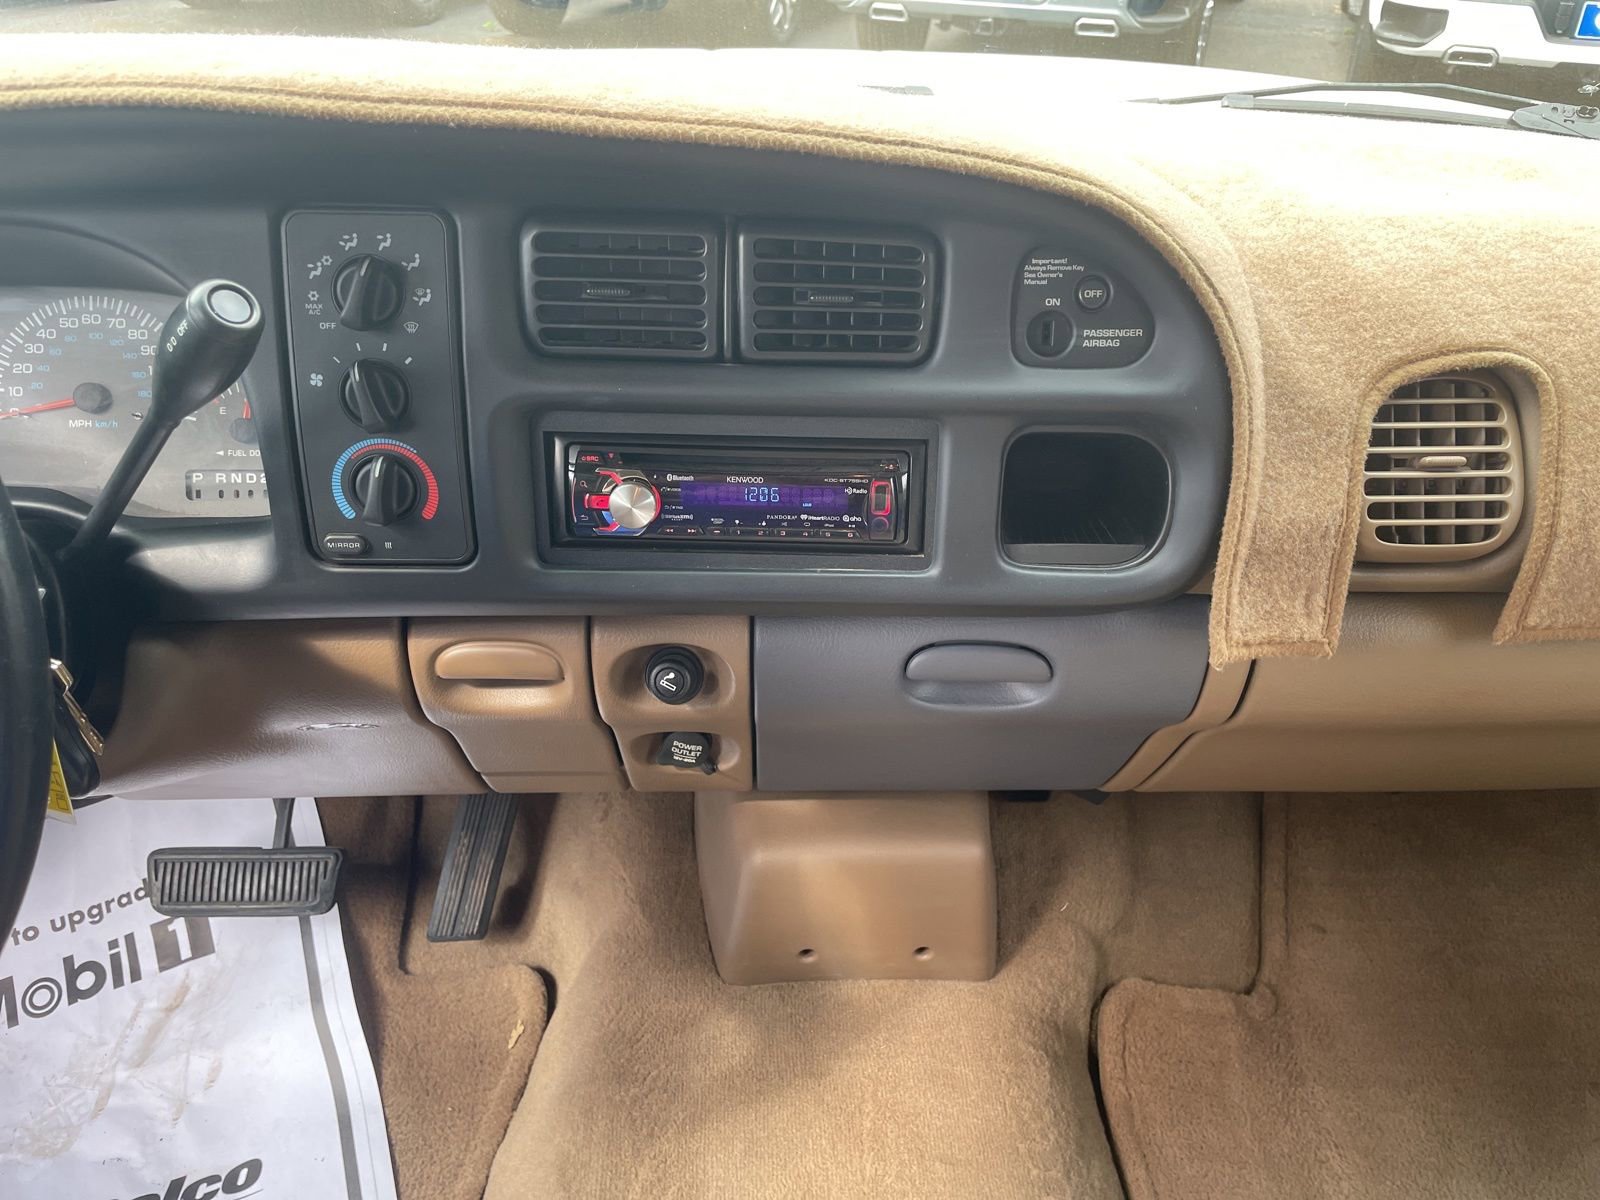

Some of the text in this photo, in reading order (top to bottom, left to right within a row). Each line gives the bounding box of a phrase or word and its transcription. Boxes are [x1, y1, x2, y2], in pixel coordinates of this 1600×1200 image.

[1031, 257, 1067, 265] Important!
[1084, 290, 1103, 298] OFF
[1045, 298, 1061, 306] ON
[59, 318, 79, 328] 50
[82, 314, 101, 325] 60
[106, 318, 126, 329] 70
[177, 319, 189, 336] OFF
[319, 322, 337, 330] OFF
[36, 329, 56, 339] 40
[128, 329, 148, 340] 80
[1083, 329, 1143, 337] PASSENGER
[1083, 339, 1120, 347] AIRBAG
[24, 344, 44, 354] 30
[13, 363, 33, 374] 20
[8, 386, 23, 397] 10
[219, 406, 227, 415] E
[68, 419, 118, 428] MPH km/h
[192, 473, 203, 483] P
[216, 473, 227, 483] R
[231, 473, 242, 483] N
[246, 473, 257, 483] D
[726, 476, 764, 484] KENWOOD
[673, 740, 702, 751] POWER
[671, 747, 702, 757] OUTLET
[11, 878, 149, 946] to upgrad
